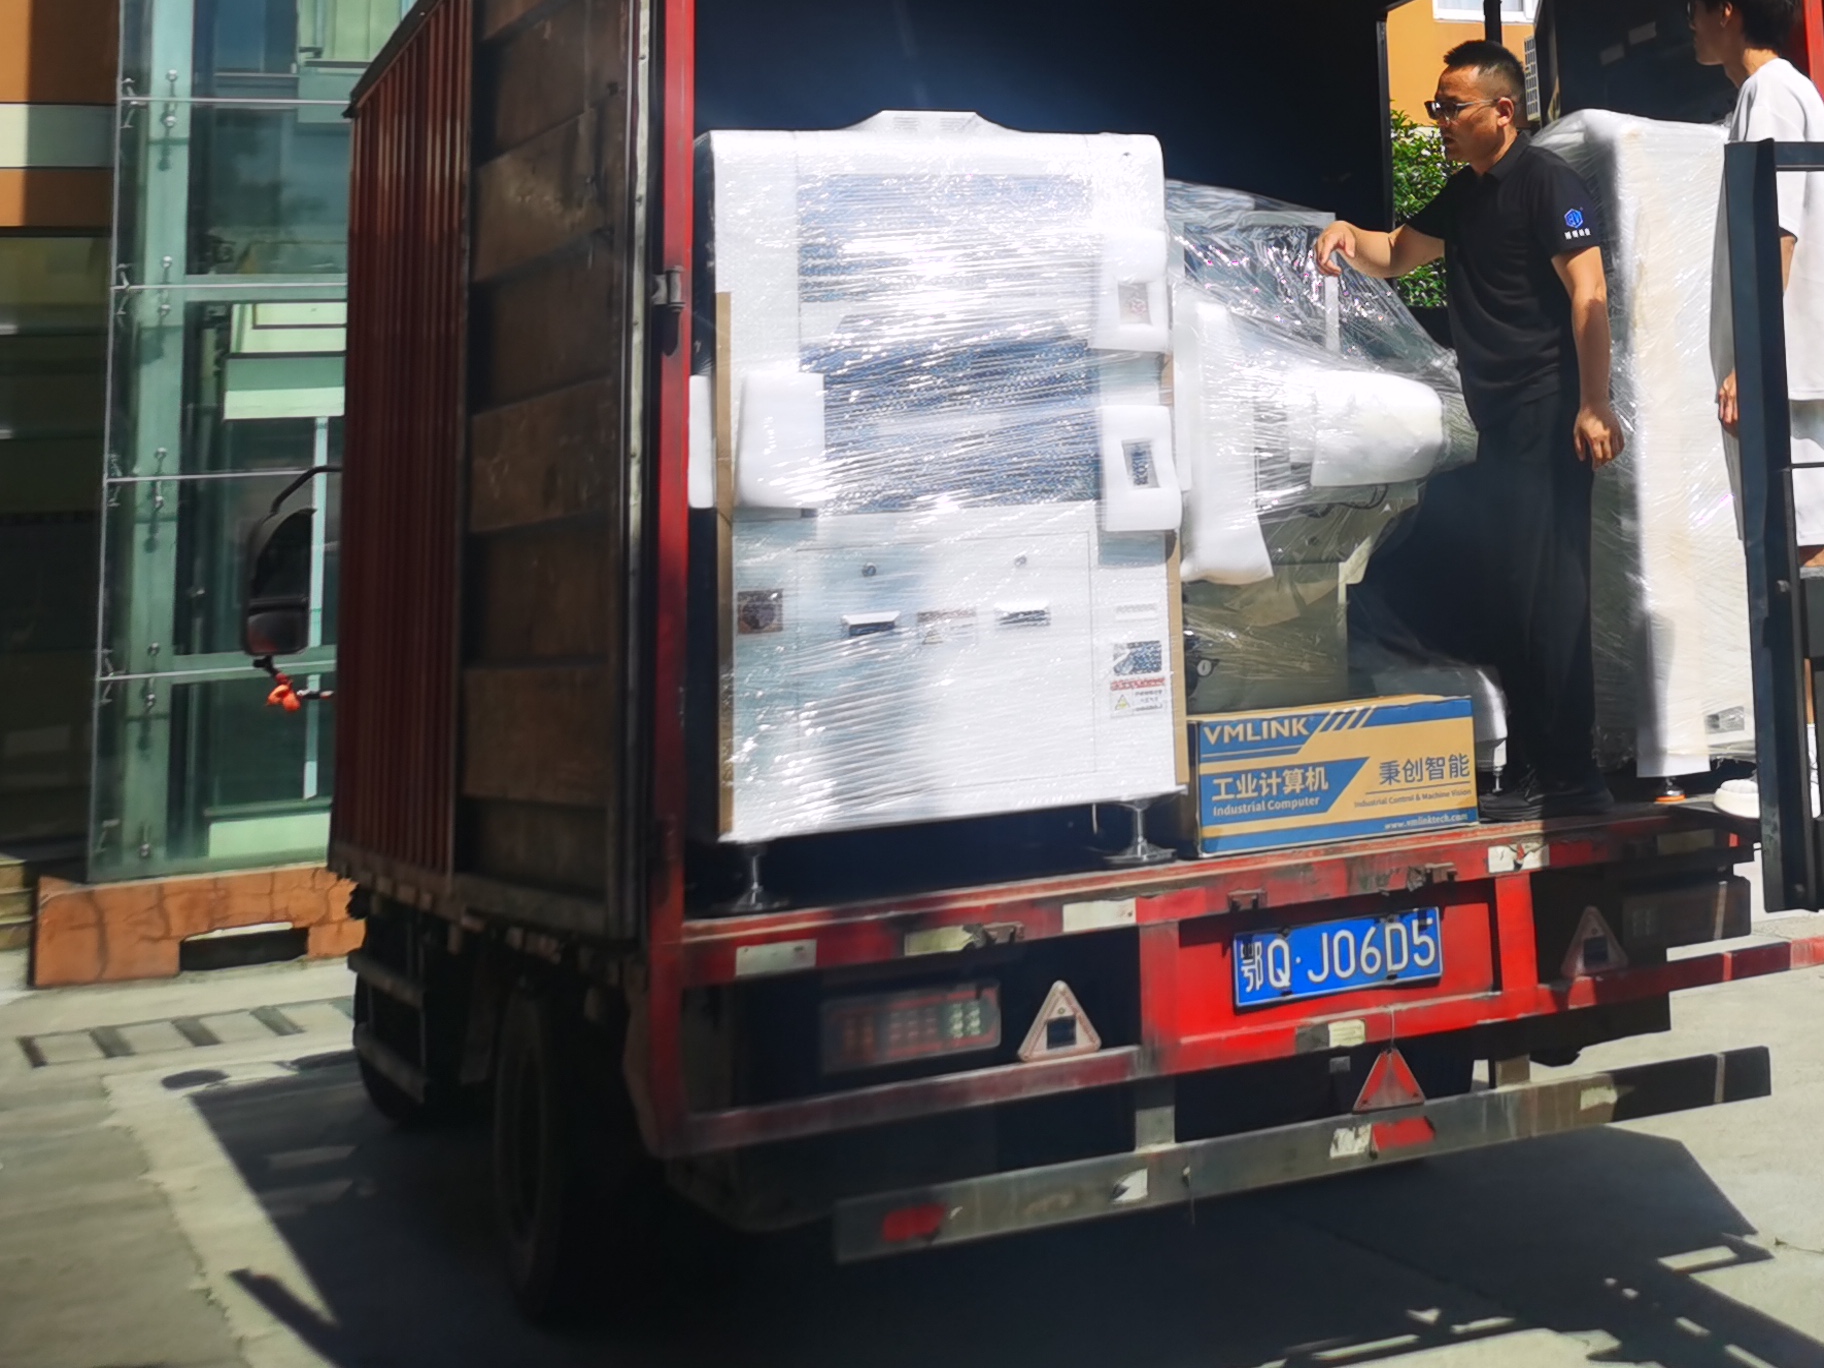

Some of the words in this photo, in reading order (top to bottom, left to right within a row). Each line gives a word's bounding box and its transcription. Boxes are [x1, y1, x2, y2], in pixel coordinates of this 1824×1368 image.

[1203, 717, 1310, 745] VMLINK
[1379, 753, 1471, 786] 秉创智能
[1211, 765, 1329, 801] 工业计算机
[1213, 800, 1265, 816] Industrial
[1267, 796, 1320, 811] Computer
[1354, 797, 1388, 808] Industrial
[1389, 794, 1414, 804] Control
[1422, 791, 1450, 801] Machine
[1451, 788, 1472, 797] Vision
[1384, 813, 1468, 830] www.vmlinktech.com
